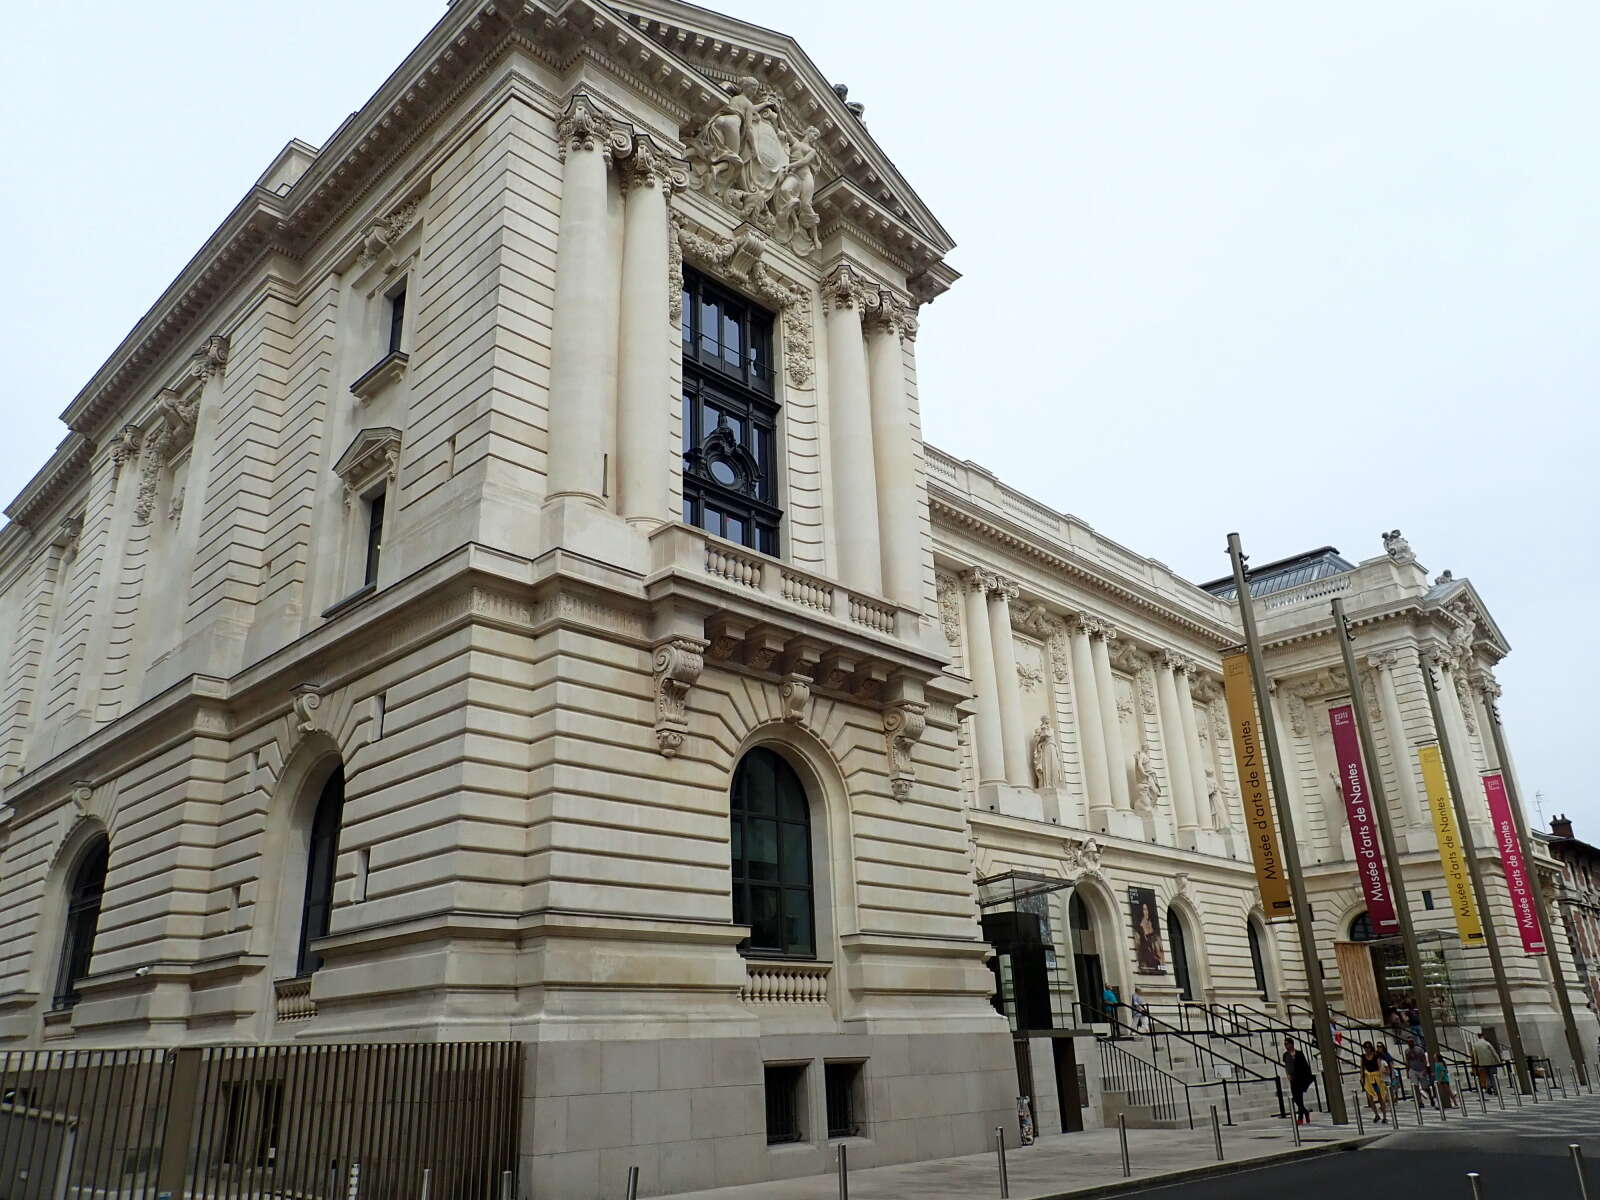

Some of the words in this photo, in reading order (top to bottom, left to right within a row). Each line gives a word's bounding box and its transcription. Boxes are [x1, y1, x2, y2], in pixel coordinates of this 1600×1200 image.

[1241, 720, 1256, 767] Nantes
[1246, 771, 1260, 788] de
[1348, 763, 1364, 804] Nantes
[1252, 792, 1268, 830] d'arts
[1353, 807, 1367, 822] de
[1437, 797, 1451, 833] Nantes
[1360, 825, 1375, 858] d'arts
[1443, 836, 1455, 849] de
[1500, 820, 1515, 853] Nantes
[1259, 834, 1278, 880] Musée
[1448, 851, 1461, 880] d'arts
[1506, 855, 1519, 867] de
[1366, 861, 1385, 902] Musée
[1512, 869, 1525, 895] d'arts
[1456, 883, 1471, 917] Musée
[1518, 897, 1534, 929] Musée
